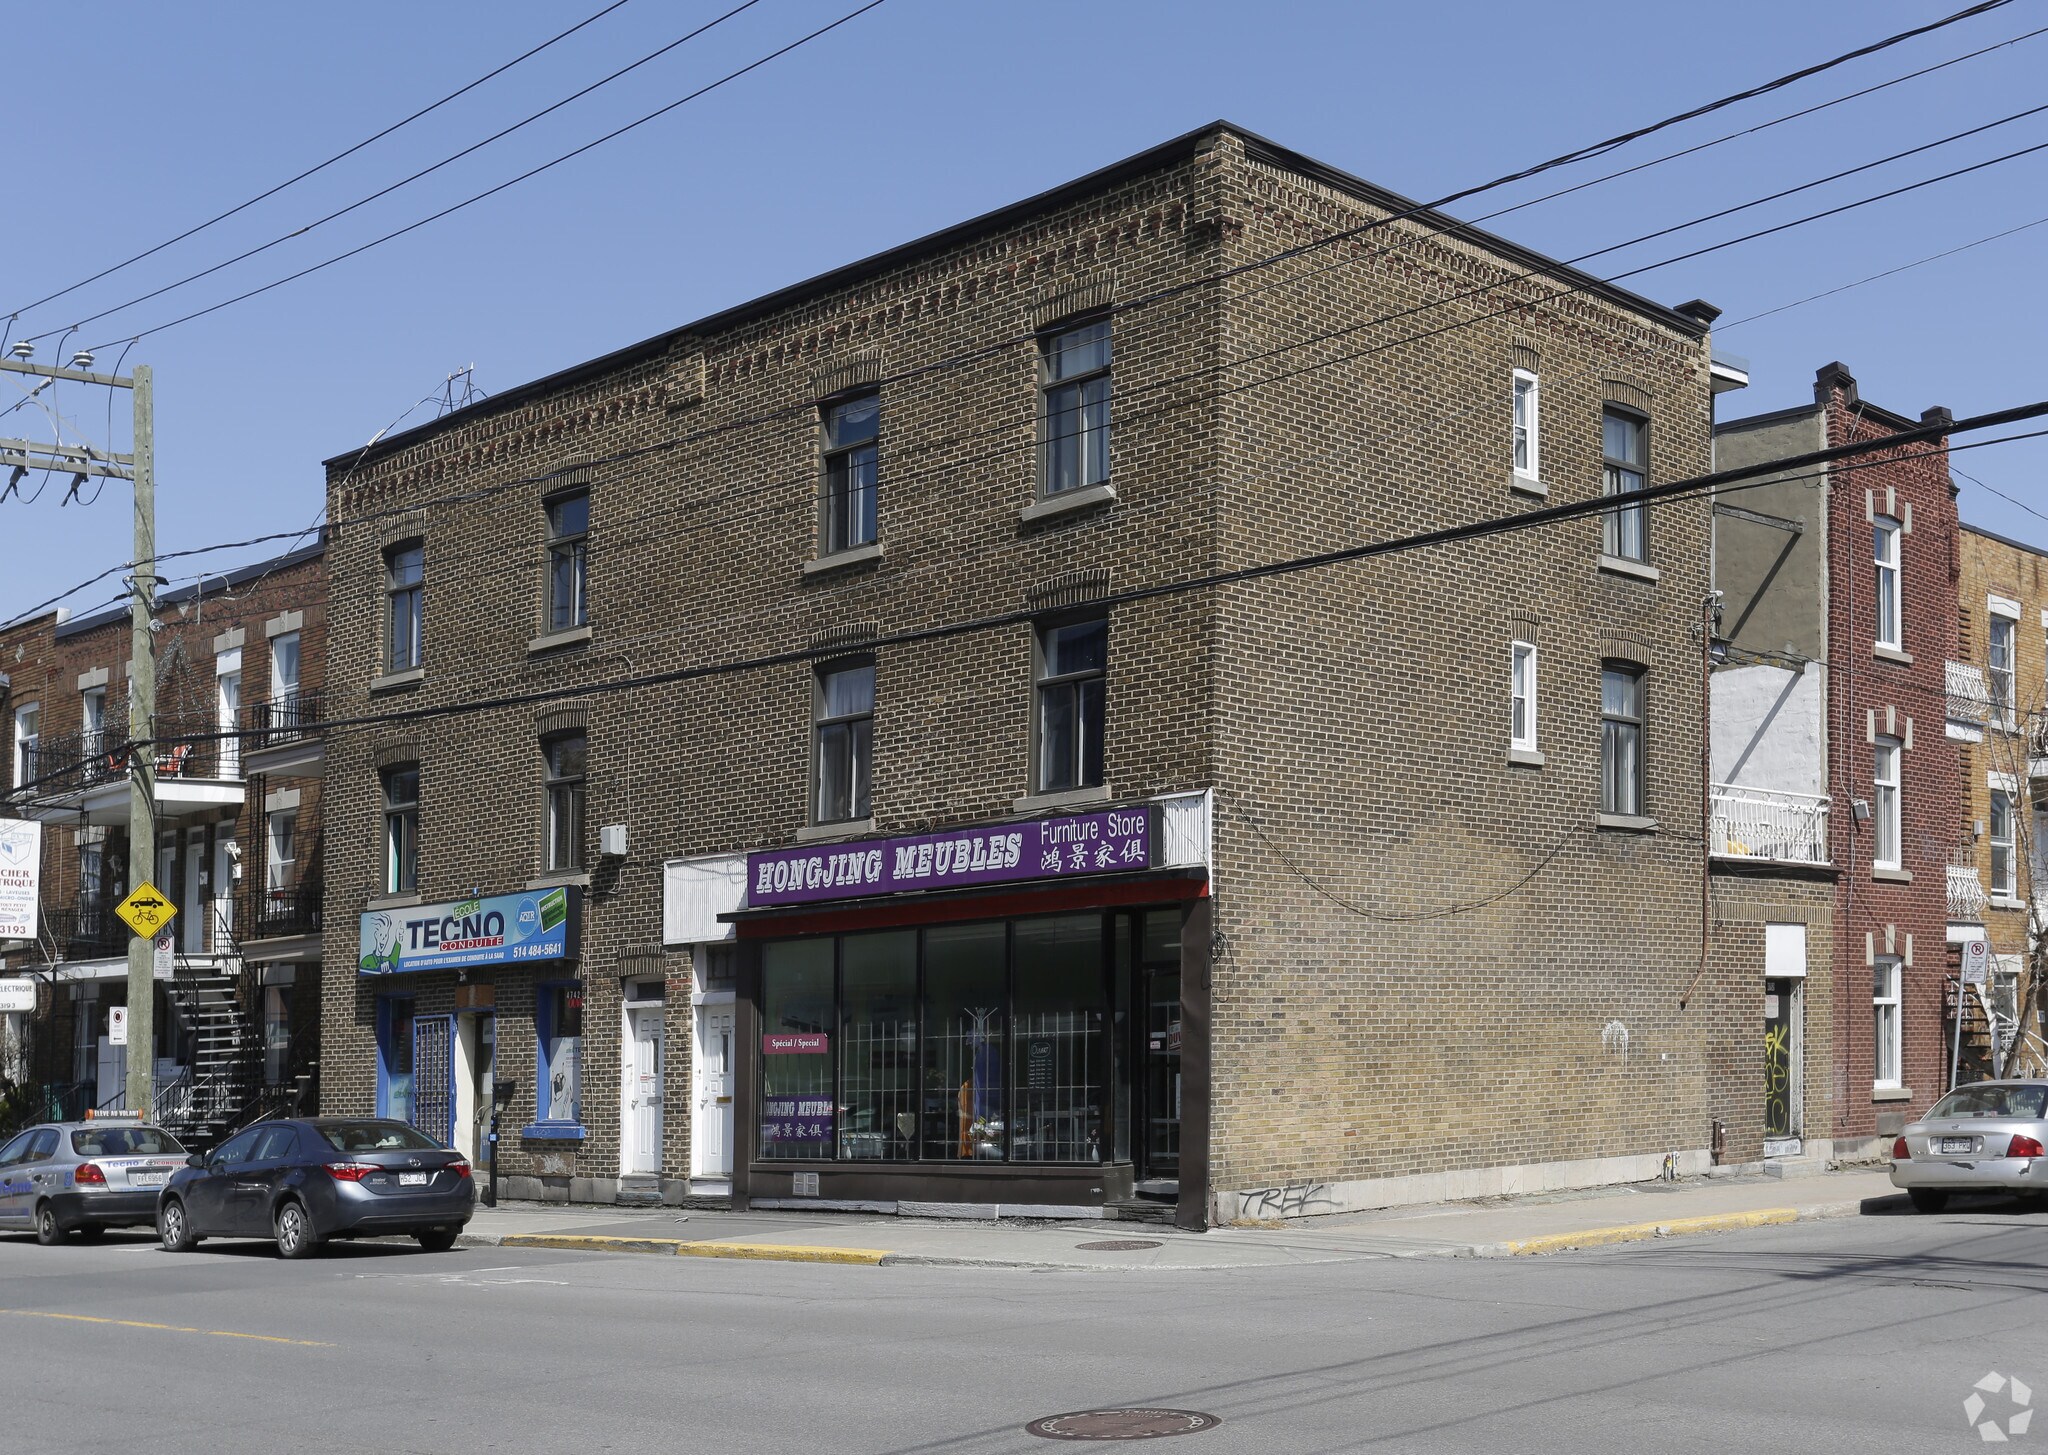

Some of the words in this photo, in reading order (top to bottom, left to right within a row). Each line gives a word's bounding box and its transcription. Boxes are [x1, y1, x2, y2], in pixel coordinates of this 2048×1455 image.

[1041, 819, 1099, 845] Furniture
[1107, 813, 1145, 838] Store
[756, 849, 883, 894] HONGJING
[893, 832, 1023, 880] MEUBLES
[1040, 838, 1146, 873] 鸿景家俱
[454, 901, 480, 919] ÉCOLE
[406, 911, 505, 950] TECNO
[440, 937, 504, 951] CONDUITE
[513, 946, 527, 958] 514
[528, 942, 562, 957] 484-5641
[798, 1038, 819, 1049] Special
[106, 1160, 139, 1168] Tecno
